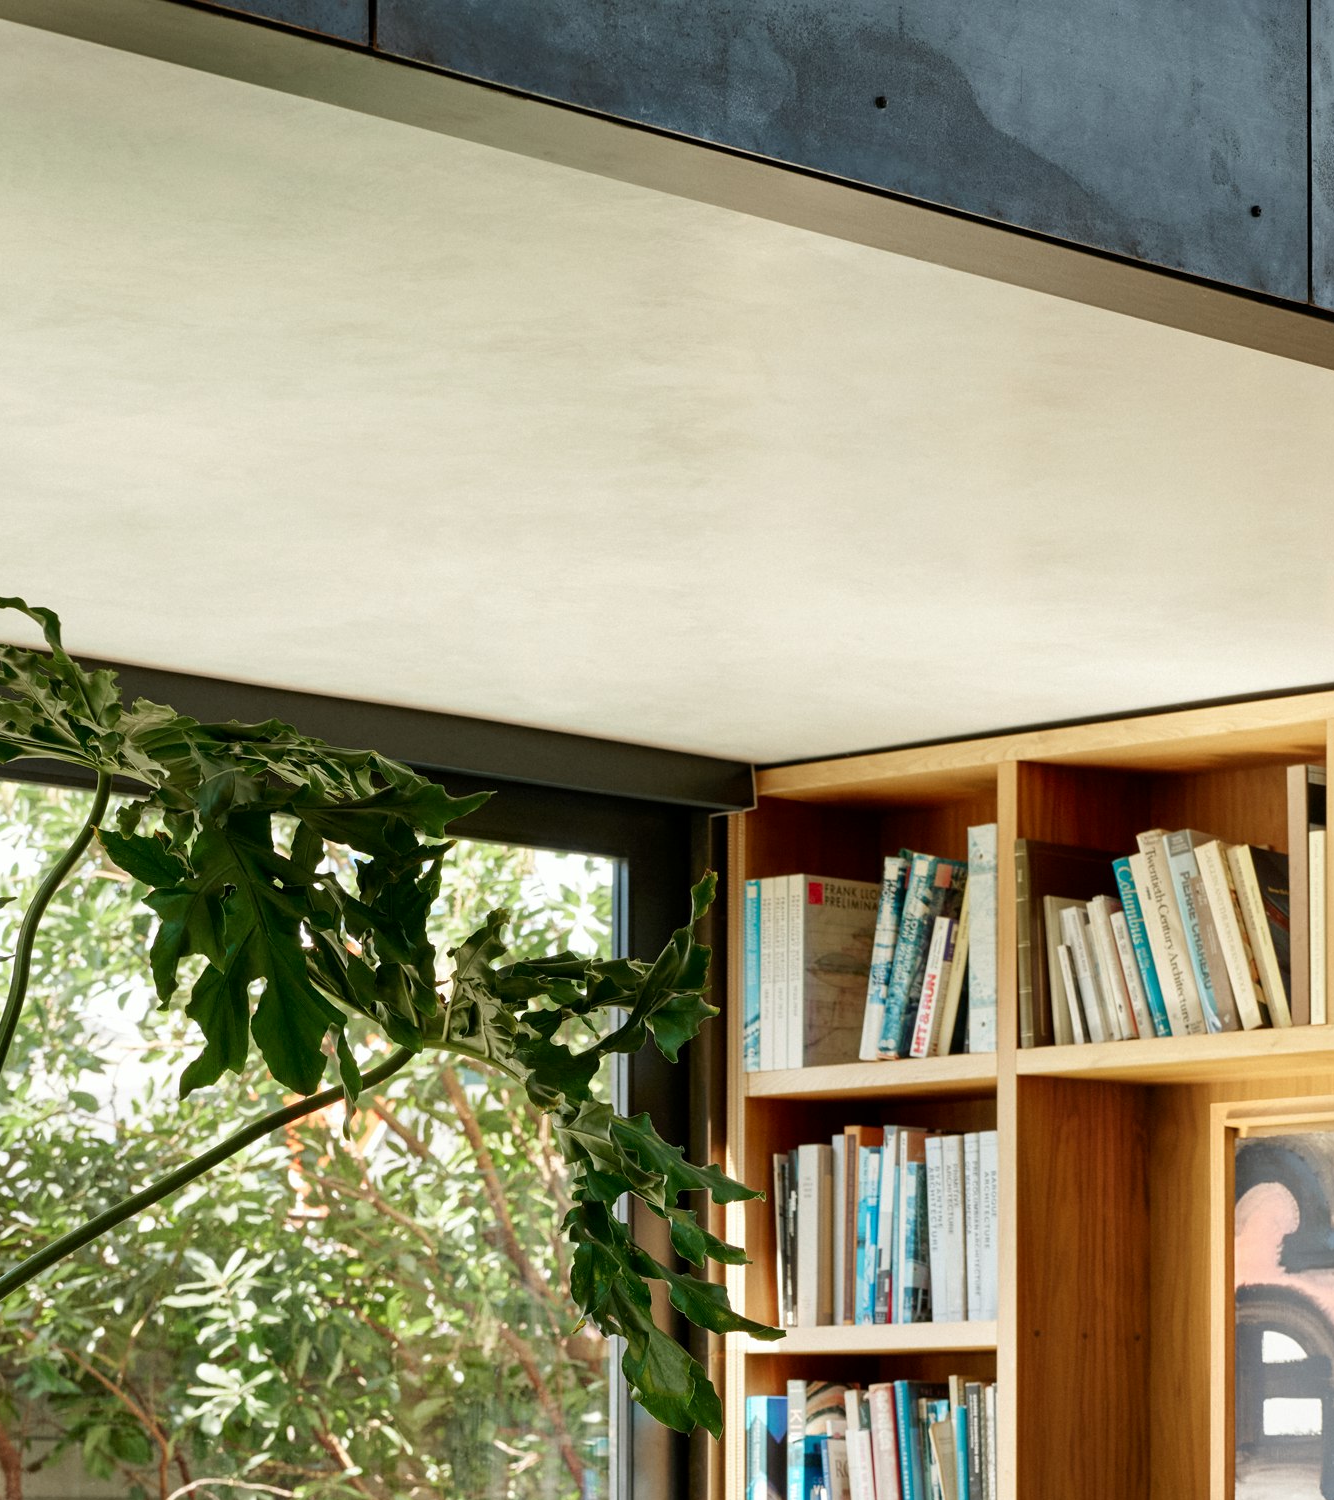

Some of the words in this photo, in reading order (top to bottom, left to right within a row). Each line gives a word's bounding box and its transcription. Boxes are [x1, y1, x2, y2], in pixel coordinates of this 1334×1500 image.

[824, 883, 855, 897] FRANK
[1115, 865, 1145, 947] Columbus
[1179, 871, 1198, 922] PIERRE
[1191, 922, 1213, 991] CHAREAU
[912, 1025, 925, 1055] HIT
[920, 973, 938, 1010] RUN
[1169, 950, 1190, 1023] Architecture
[928, 1167, 937, 1252] ARCHITECTURE
[935, 1166, 943, 1229] BYZANTINE
[946, 1165, 954, 1235] ARCHITECTURE
